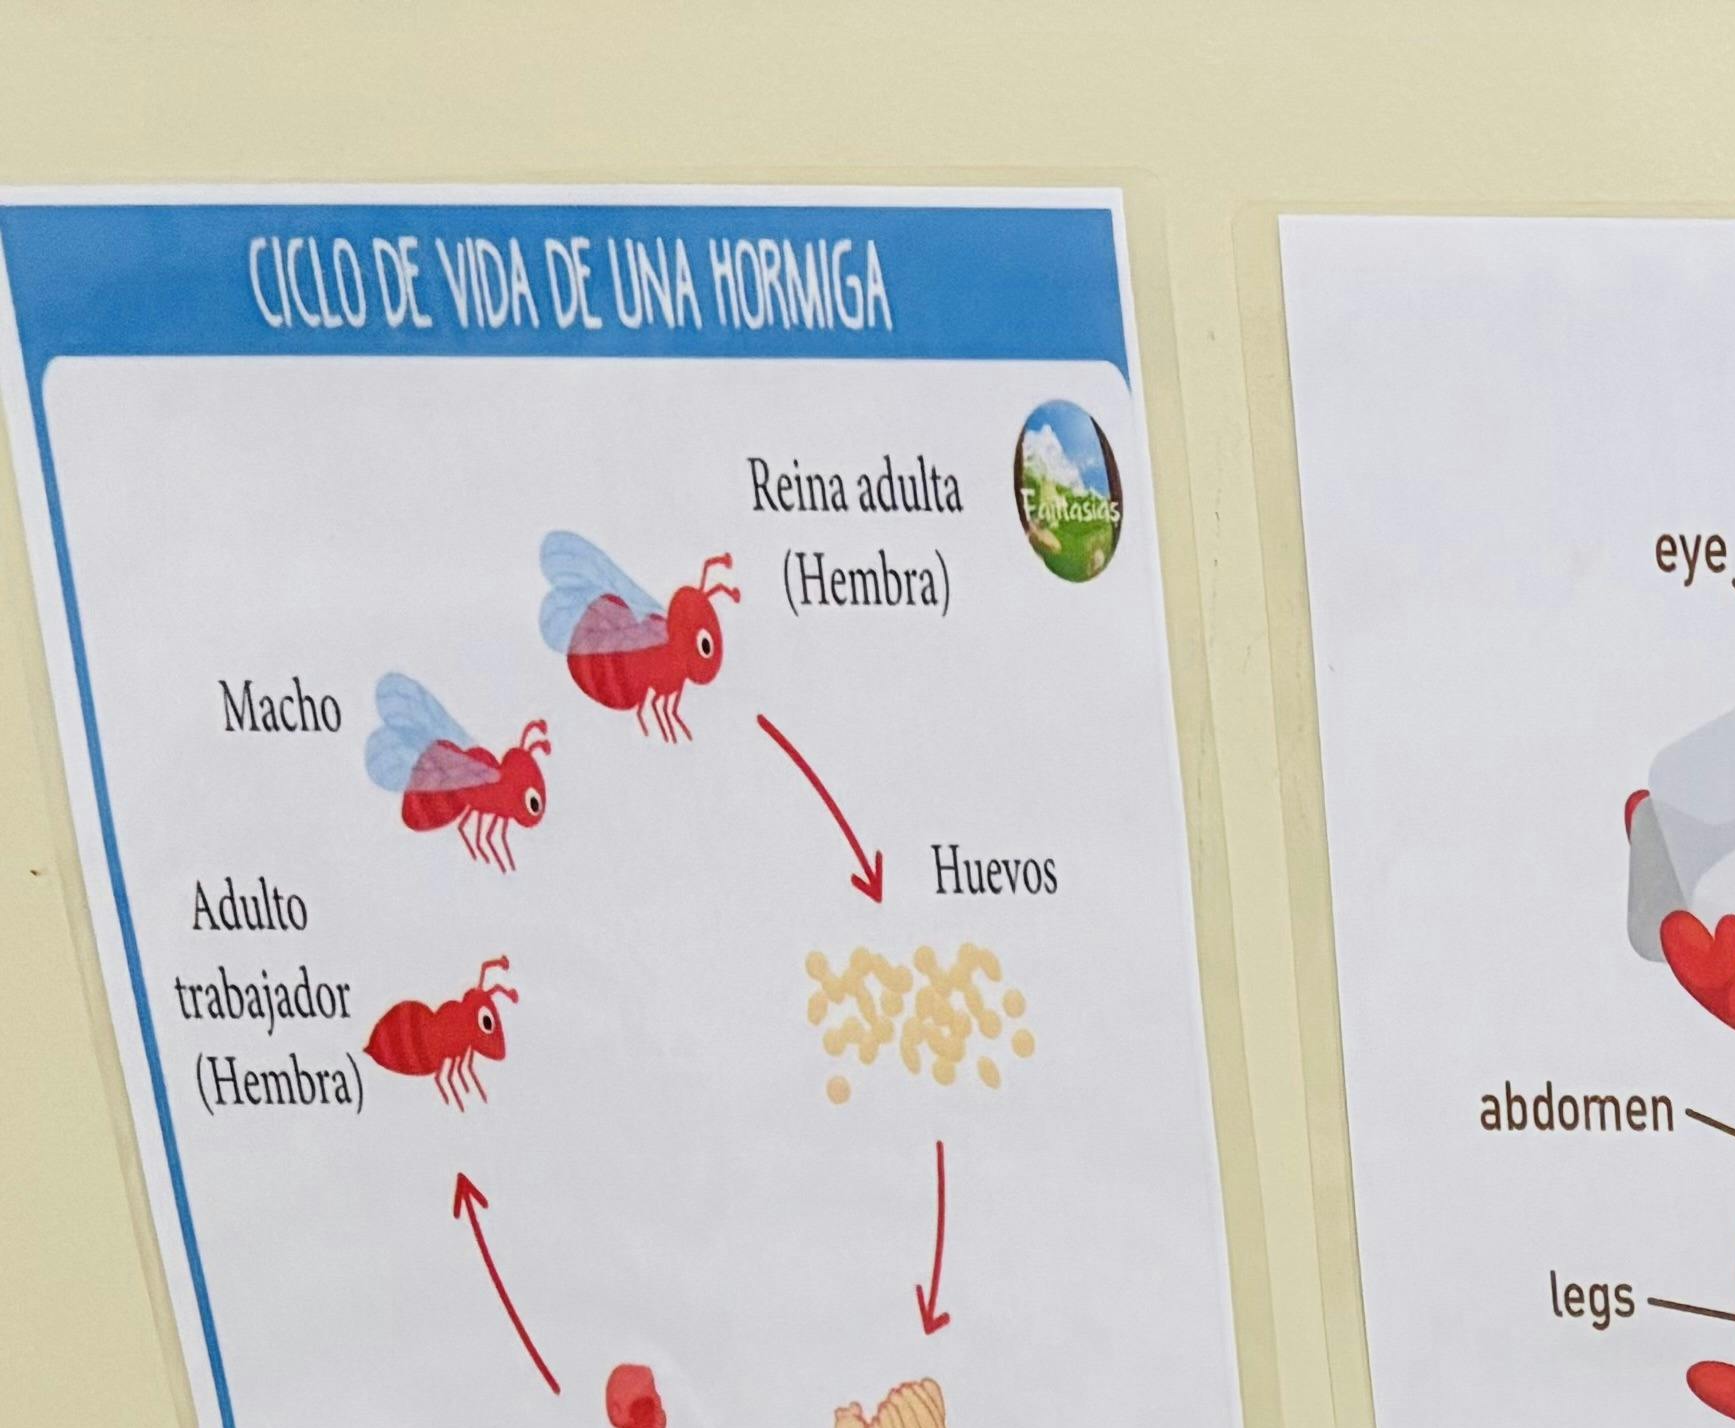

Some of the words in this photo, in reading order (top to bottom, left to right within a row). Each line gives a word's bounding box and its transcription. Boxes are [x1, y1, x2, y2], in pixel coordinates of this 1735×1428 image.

[249, 235, 367, 329] CICLO
[372, 235, 433, 329] DE
[434, 236, 540, 329] VIDA
[544, 236, 604, 330] DE
[607, 236, 703, 330] UNA
[708, 238, 893, 331] HORMIGA
[746, 456, 850, 513] Reina
[856, 454, 964, 514] adulta
[783, 548, 950, 617] (Hembra)
[1655, 533, 1727, 588] eye
[217, 675, 342, 733] Macho
[930, 843, 1058, 895] Huevos
[192, 875, 308, 932] Adulto
[173, 964, 351, 1037] trabajador
[196, 1051, 364, 1117] (Hembra)
[1480, 1079, 1674, 1132] abdomen
[1549, 1269, 1636, 1332] legs
